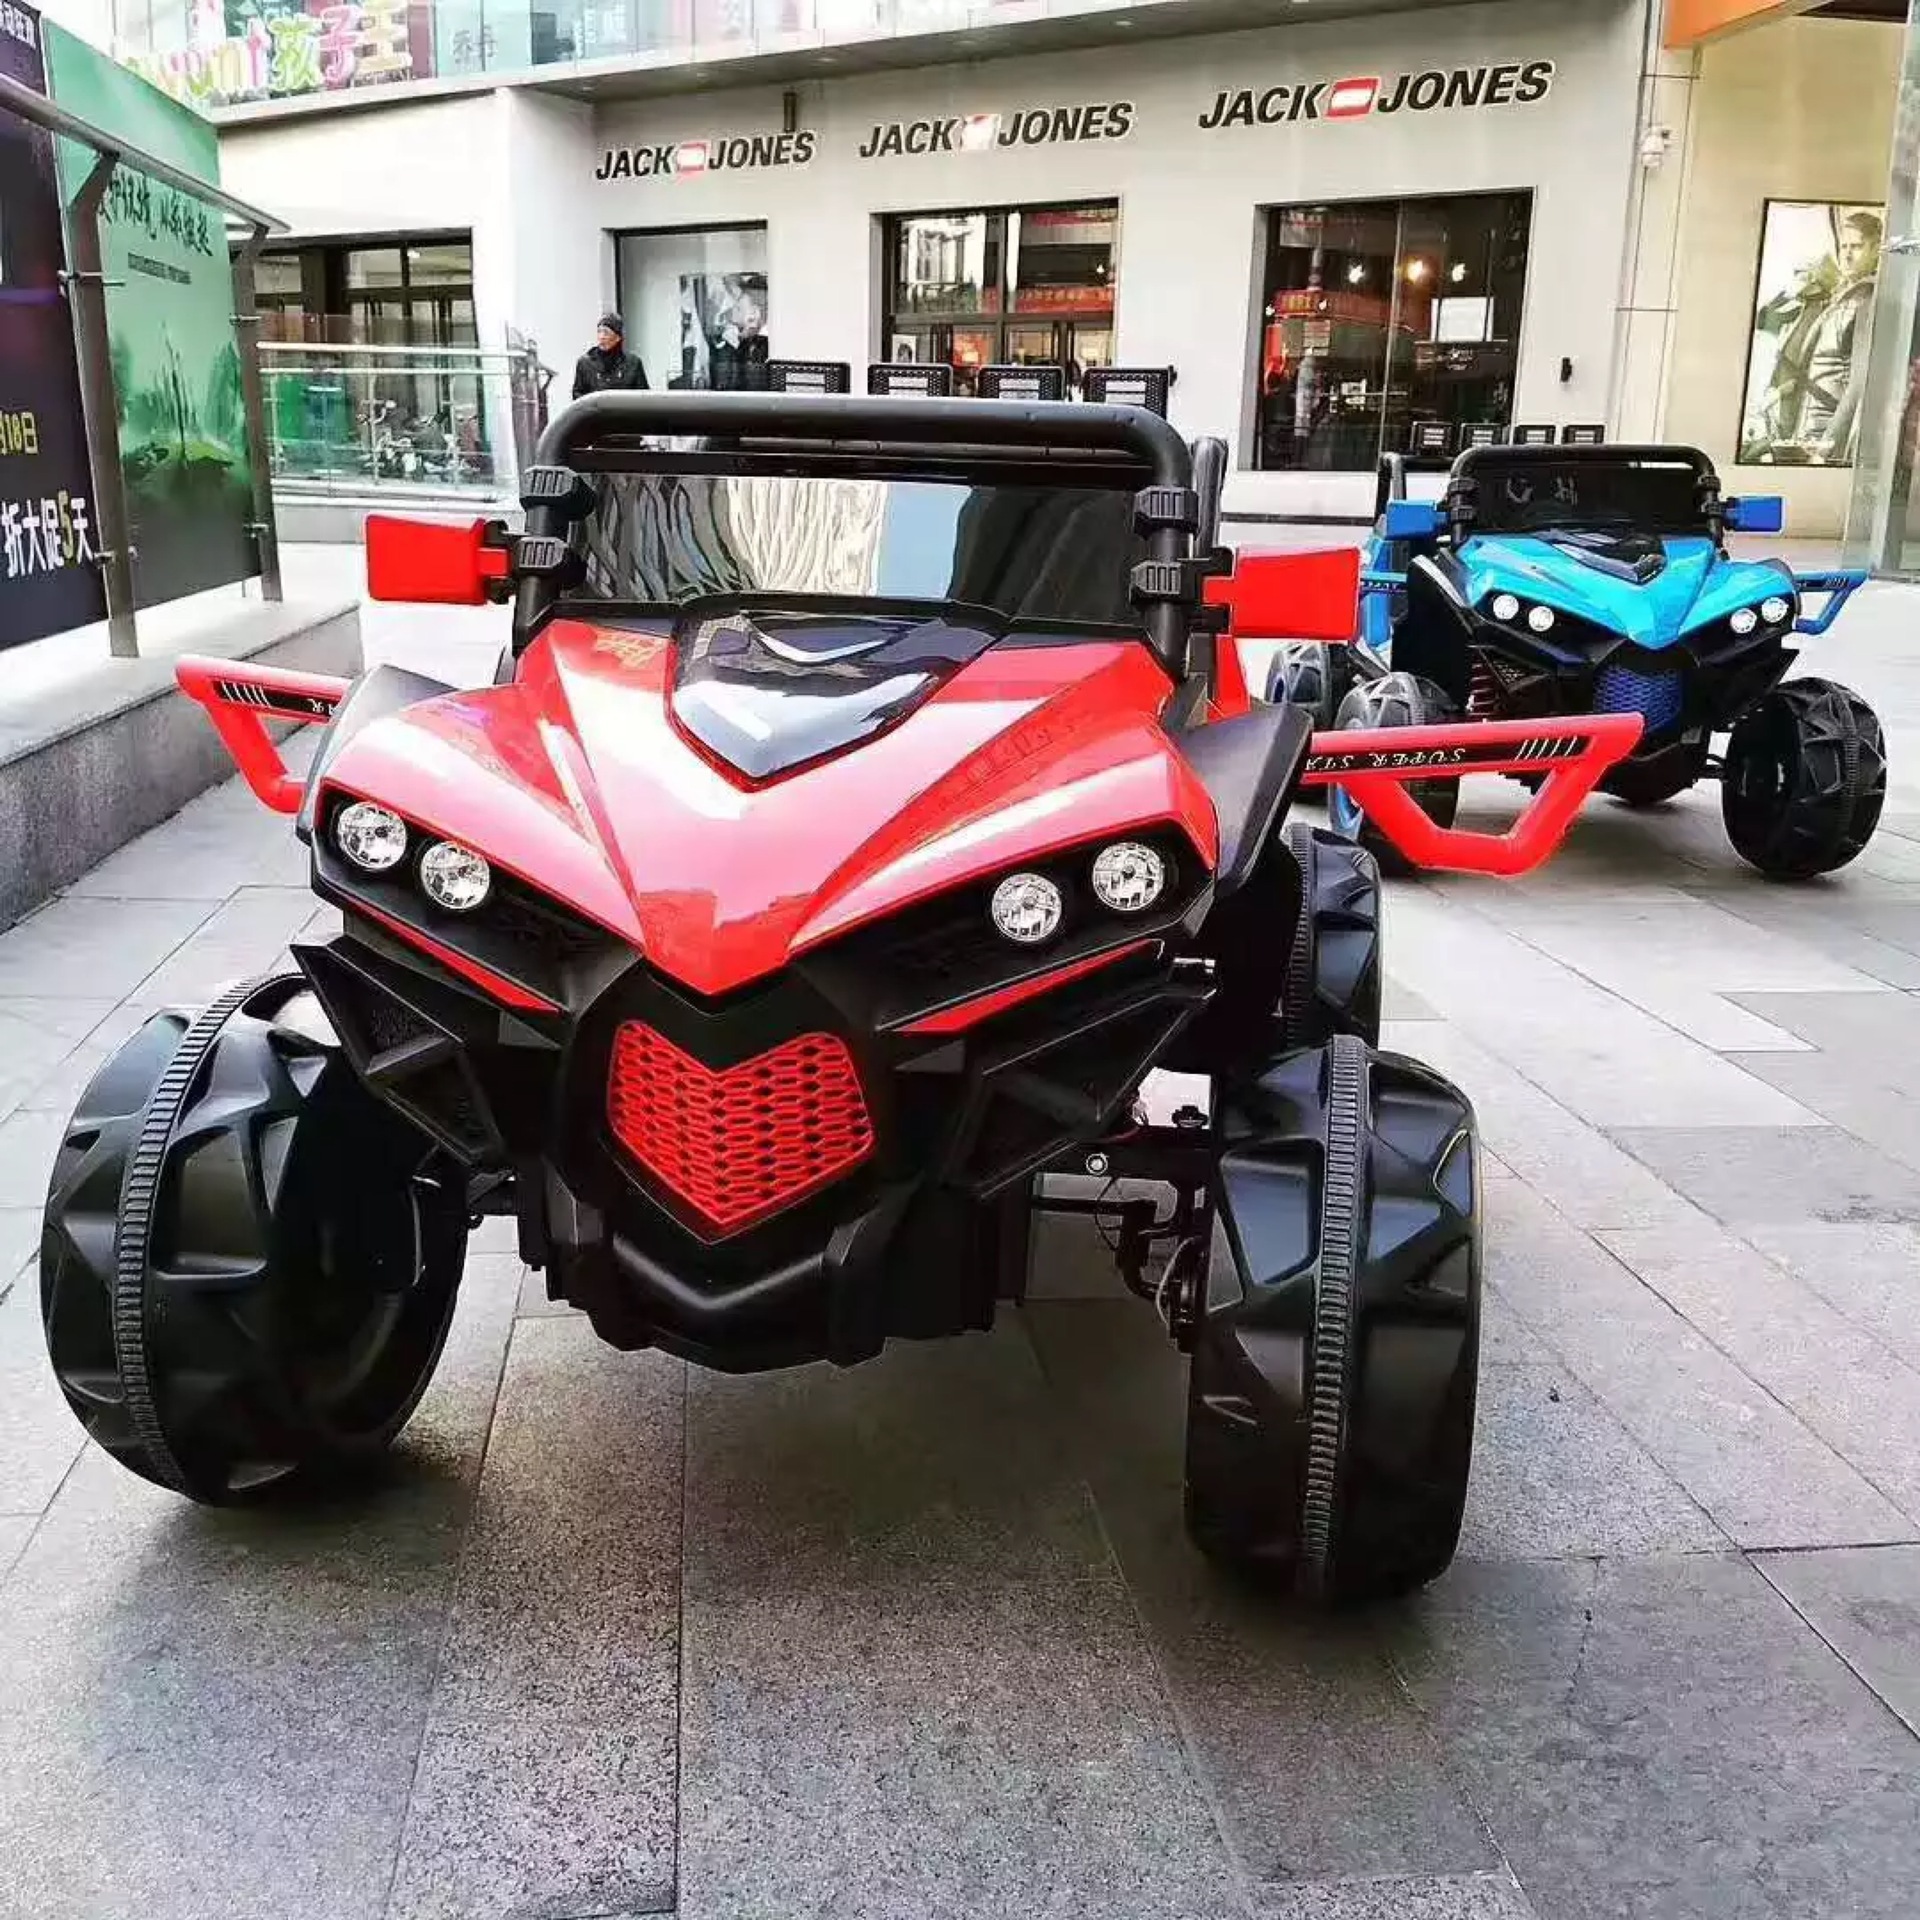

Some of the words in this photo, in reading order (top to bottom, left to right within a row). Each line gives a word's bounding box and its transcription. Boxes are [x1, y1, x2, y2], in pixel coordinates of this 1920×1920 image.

[1199, 82, 1328, 129] JACK
[1377, 61, 1554, 113] JONES
[859, 117, 959, 158] JACK
[997, 102, 1133, 147] JONES
[596, 145, 676, 181] JACK
[708, 132, 815, 170] JONES
[1368, 748, 1466, 768] SUPER
